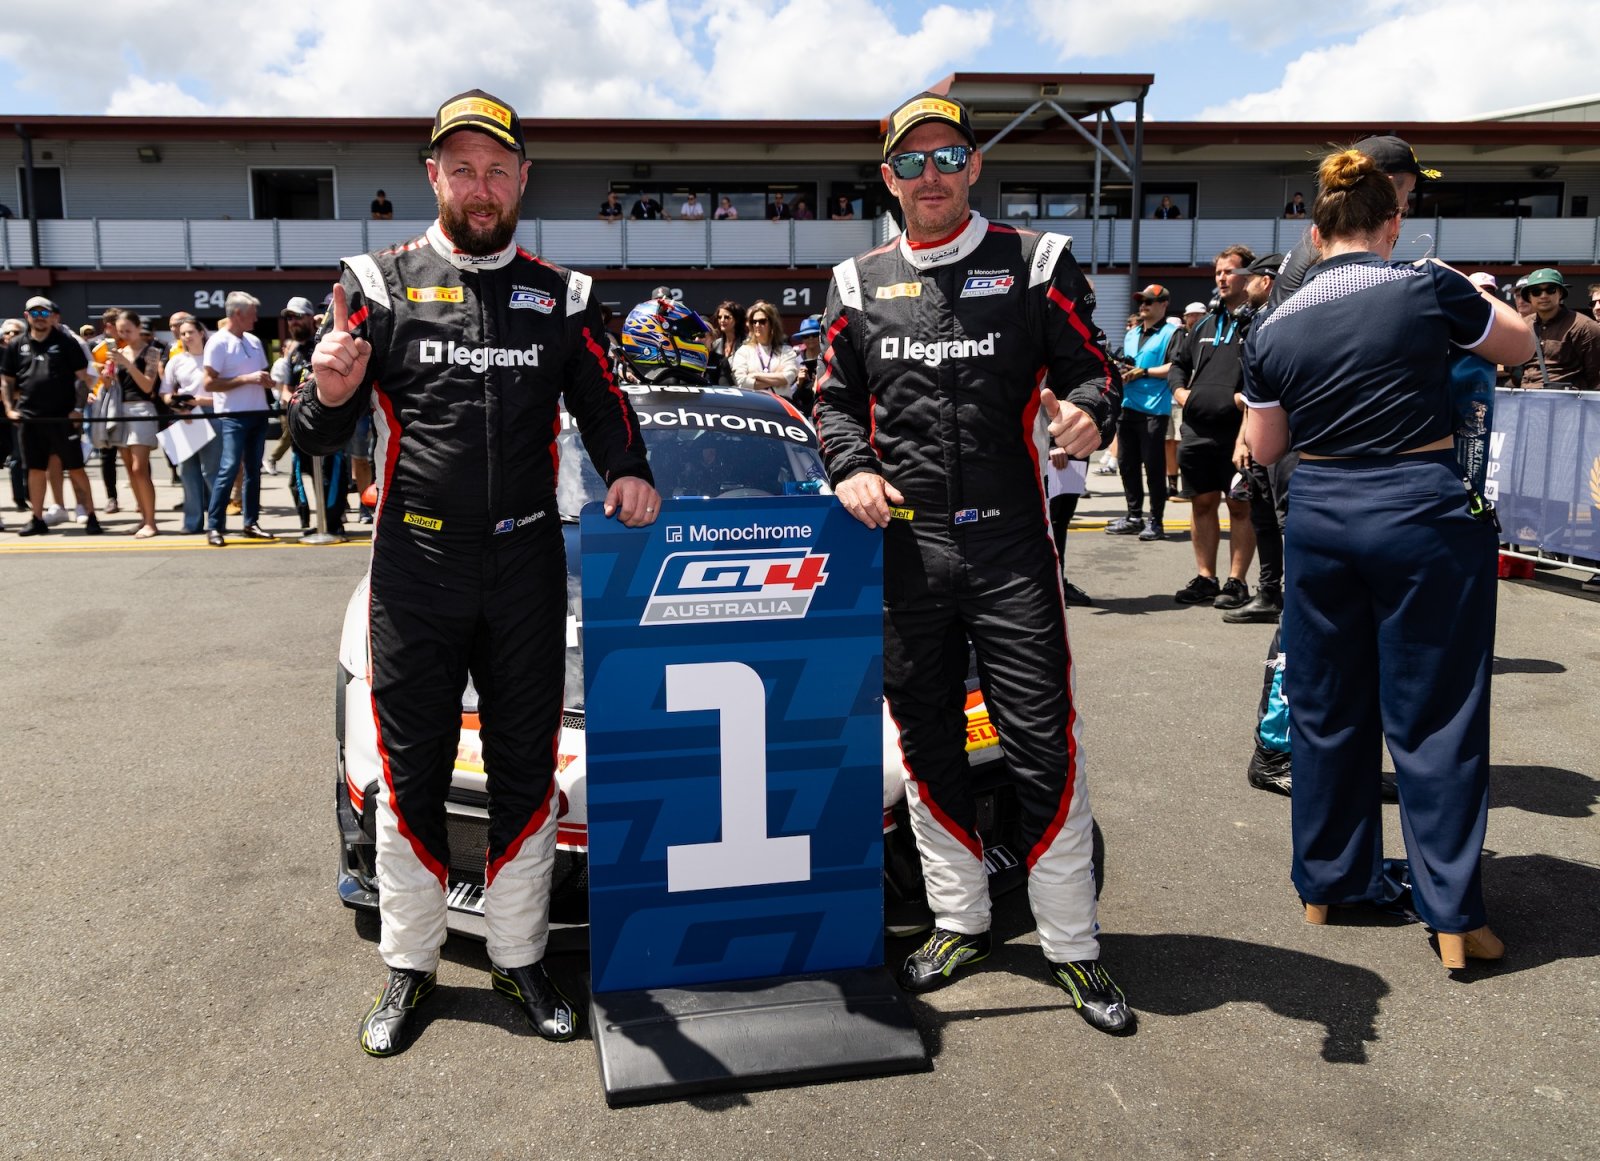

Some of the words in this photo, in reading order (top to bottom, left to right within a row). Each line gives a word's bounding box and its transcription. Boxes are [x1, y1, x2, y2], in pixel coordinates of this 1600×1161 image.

[1036, 239, 1056, 272] Sabelt
[194, 289, 225, 308] 24
[783, 287, 811, 306] 21
[447, 340, 539, 374] legrand
[903, 332, 995, 367] legrand
[619, 384, 744, 397] grand
[407, 514, 438, 529] Sabelt
[516, 510, 546, 528] Callaghan
[889, 509, 911, 520] abelt
[981, 508, 1001, 519] Lillis
[689, 523, 813, 542] Monochrome
[677, 554, 828, 592] GT4
[662, 600, 793, 618] AUSTRALIA
[665, 661, 811, 893] 1
[557, 1009, 572, 1034] OMP
[372, 1023, 388, 1051] OMP
